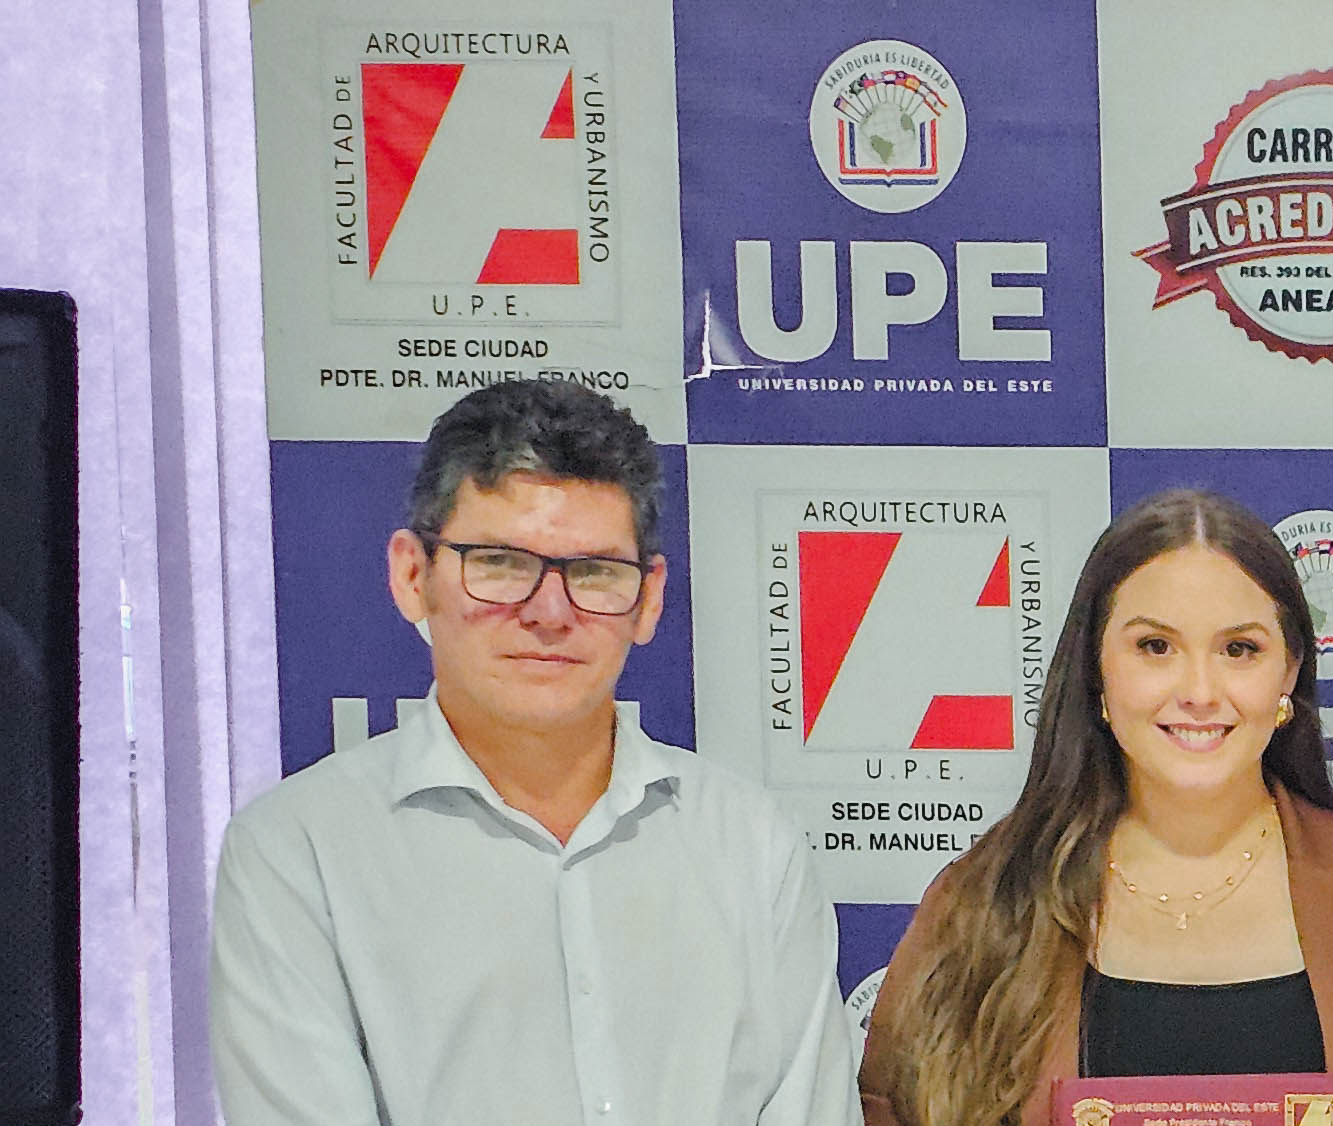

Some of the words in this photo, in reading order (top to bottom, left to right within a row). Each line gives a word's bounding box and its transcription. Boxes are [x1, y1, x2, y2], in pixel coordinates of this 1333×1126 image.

[366, 33, 569, 57] ARQUITECTURA
[825, 52, 881, 89] SABIDURIA
[885, 52, 897, 63] ES
[900, 54, 950, 90] LIBERTAD
[337, 74, 352, 104] DE
[336, 113, 357, 266] FACULTAD
[584, 91, 609, 264] URBANISMO
[1240, 266, 1271, 277] RES.
[1305, 266, 1331, 278] DEL
[734, 240, 1052, 364] UPE
[398, 339, 457, 357] SEDE
[464, 339, 548, 358] CIUDAD
[320, 370, 384, 387] PDTE.
[392, 370, 428, 388] DR.
[738, 378, 865, 393] UNIVERSIDAD
[874, 378, 955, 392] PRIVADA
[963, 379, 1000, 392] DEL
[1007, 379, 1054, 392] ESTE
[804, 501, 1006, 526] ARQUITECTURA
[1281, 523, 1316, 542] DURIA
[1320, 522, 1332, 533] ES
[773, 543, 788, 570] DE
[772, 581, 791, 730] FACULTAD
[832, 802, 890, 821] SEDE
[898, 803, 983, 821] CIUDAD
[825, 833, 862, 850] DR.
[870, 833, 963, 851] MANUEL
